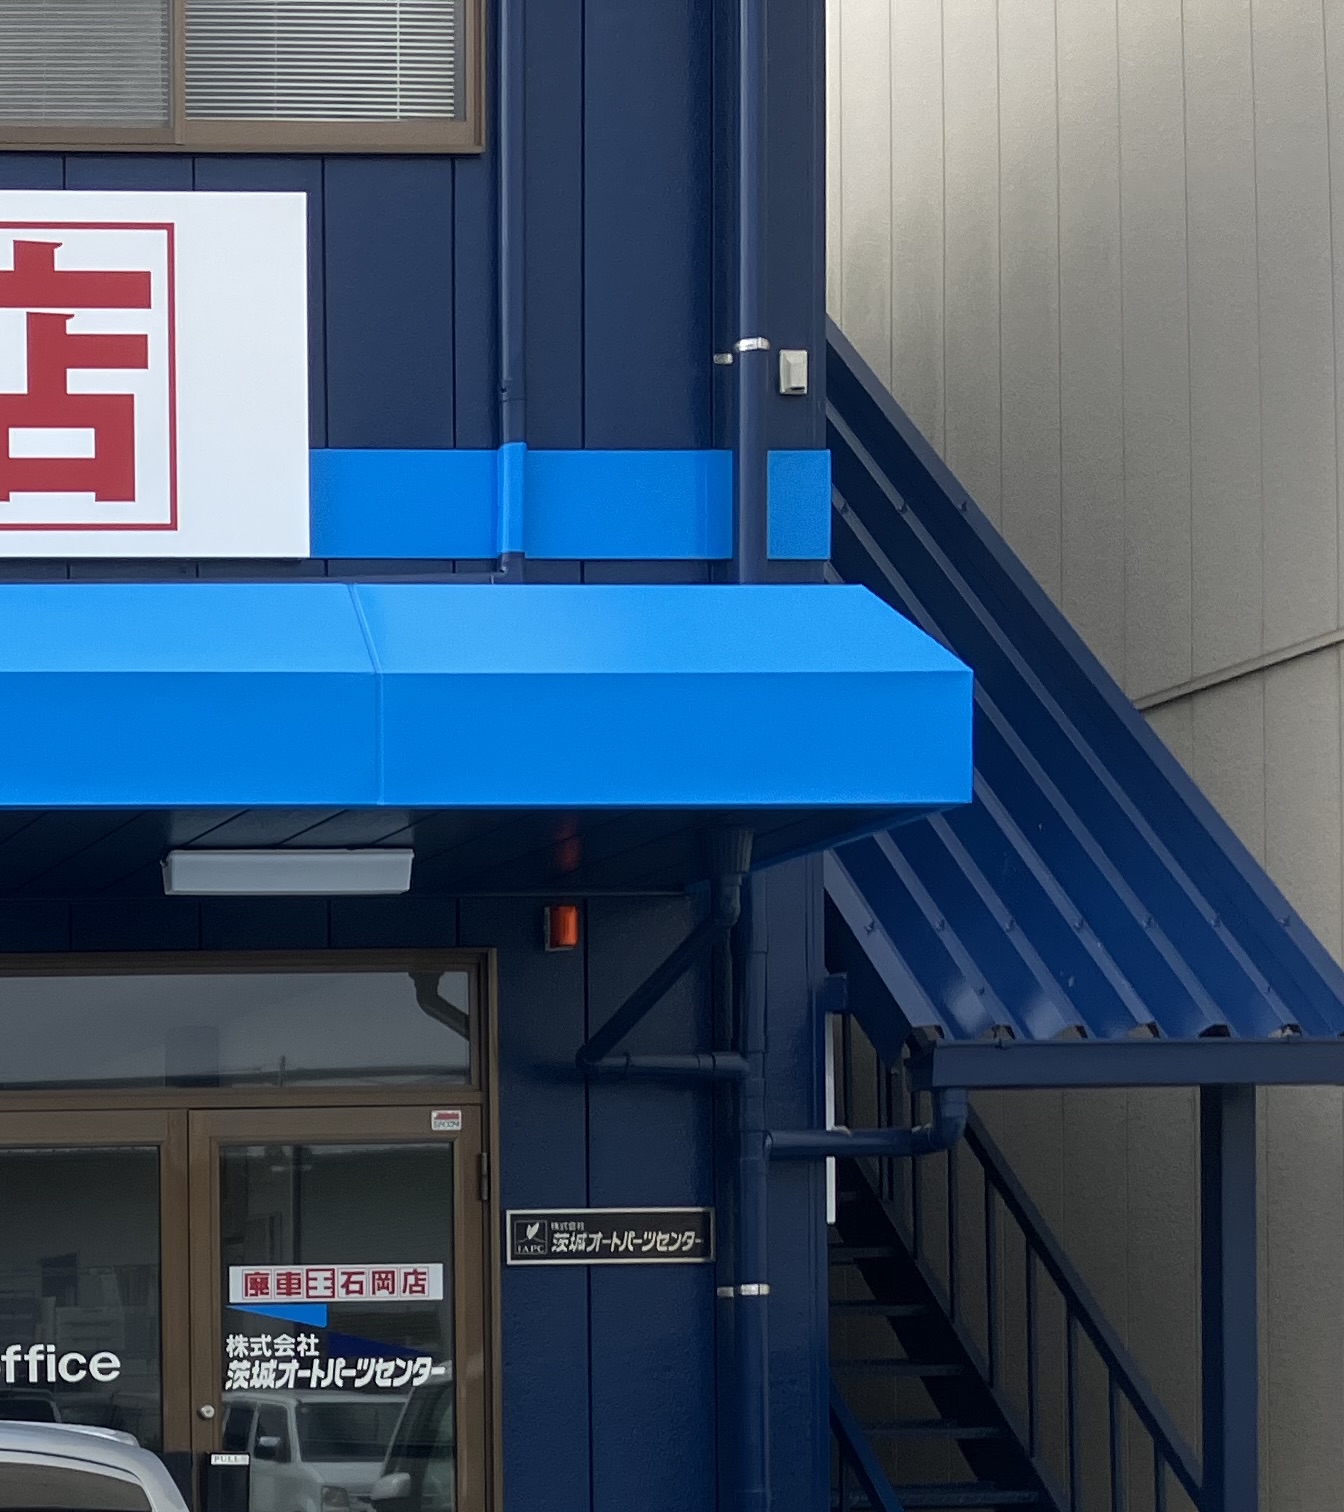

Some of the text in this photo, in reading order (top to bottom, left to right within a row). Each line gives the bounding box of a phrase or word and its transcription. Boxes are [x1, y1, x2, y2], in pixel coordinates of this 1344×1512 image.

[551, 1230, 702, 1252] 茨城オートパーツセンター
[244, 1268, 428, 1298] 廃車王石岡店
[225, 1334, 320, 1358] 株式会社
[224, 1357, 446, 1391] 茨城オートパーツセンター
